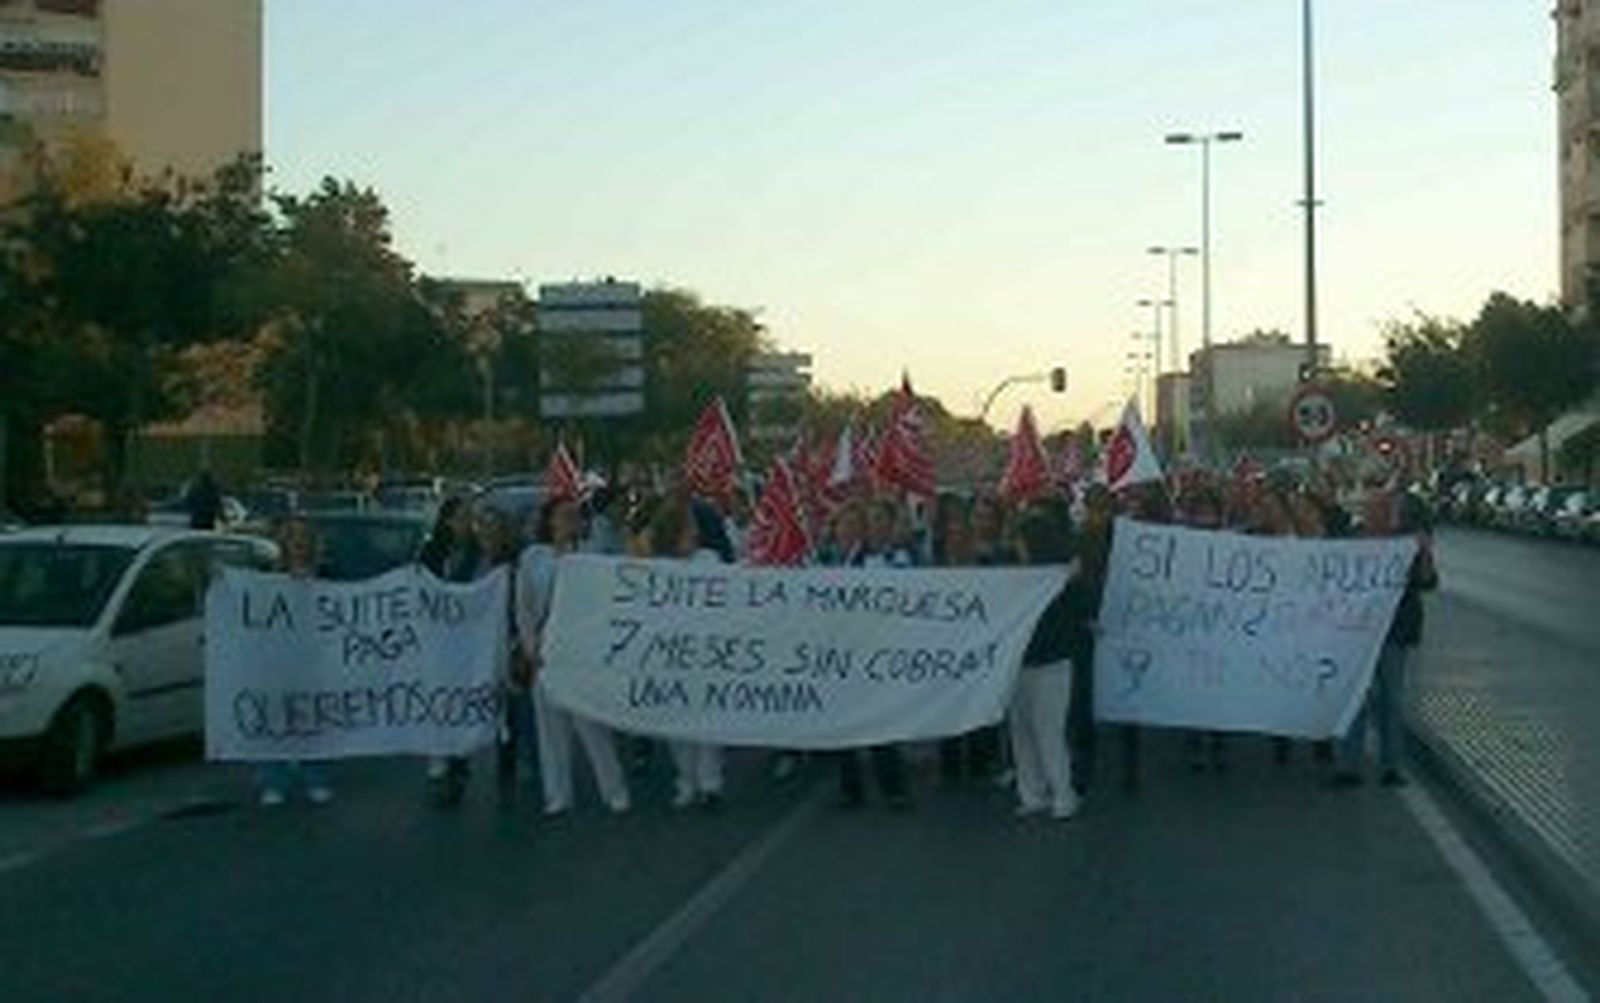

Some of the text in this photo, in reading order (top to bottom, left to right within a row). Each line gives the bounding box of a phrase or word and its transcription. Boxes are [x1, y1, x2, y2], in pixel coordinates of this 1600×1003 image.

[1131, 533, 1177, 580] SI
[1206, 544, 1277, 594] LOS
[241, 589, 298, 631] LA
[611, 562, 990, 623] SUITE LA MARQUESA
[342, 624, 422, 665] PAGA
[603, 618, 643, 667] 7
[639, 632, 768, 675] MESES
[783, 641, 852, 680] SIN
[628, 676, 689, 710] UNA
